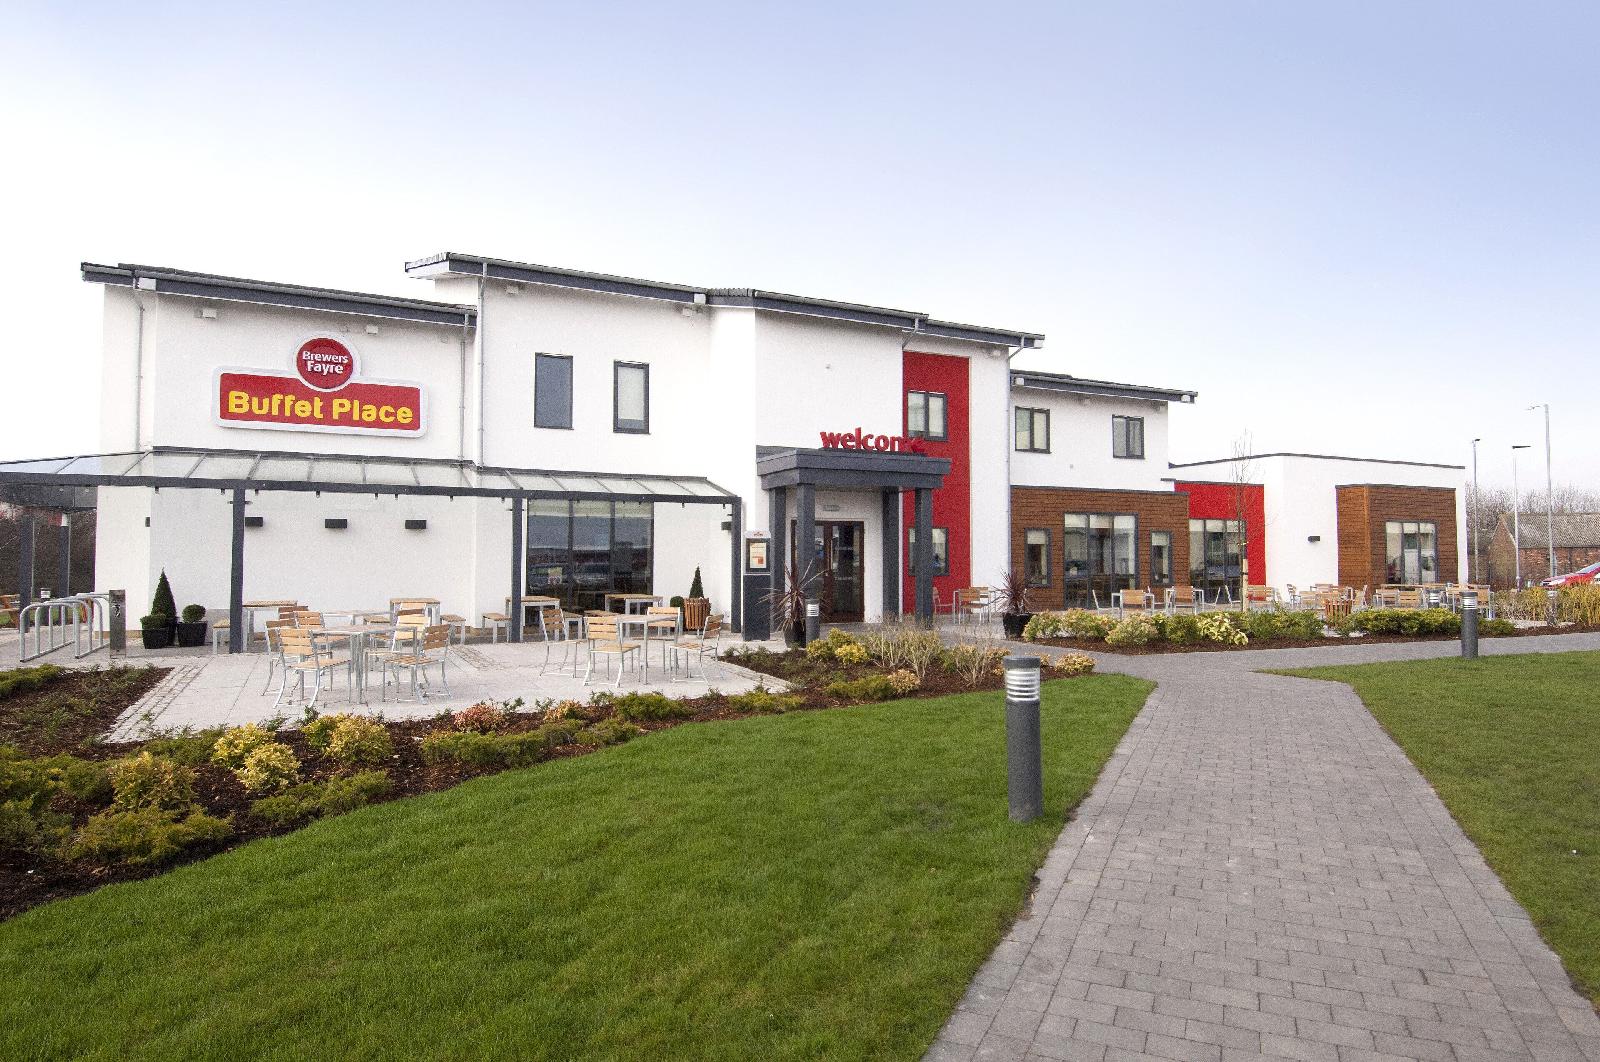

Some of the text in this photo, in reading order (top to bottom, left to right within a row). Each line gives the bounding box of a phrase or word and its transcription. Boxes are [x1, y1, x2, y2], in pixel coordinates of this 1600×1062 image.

[302, 350, 349, 364] Brewers
[307, 360, 344, 376] Fayre
[228, 390, 413, 424] Buffet Place
